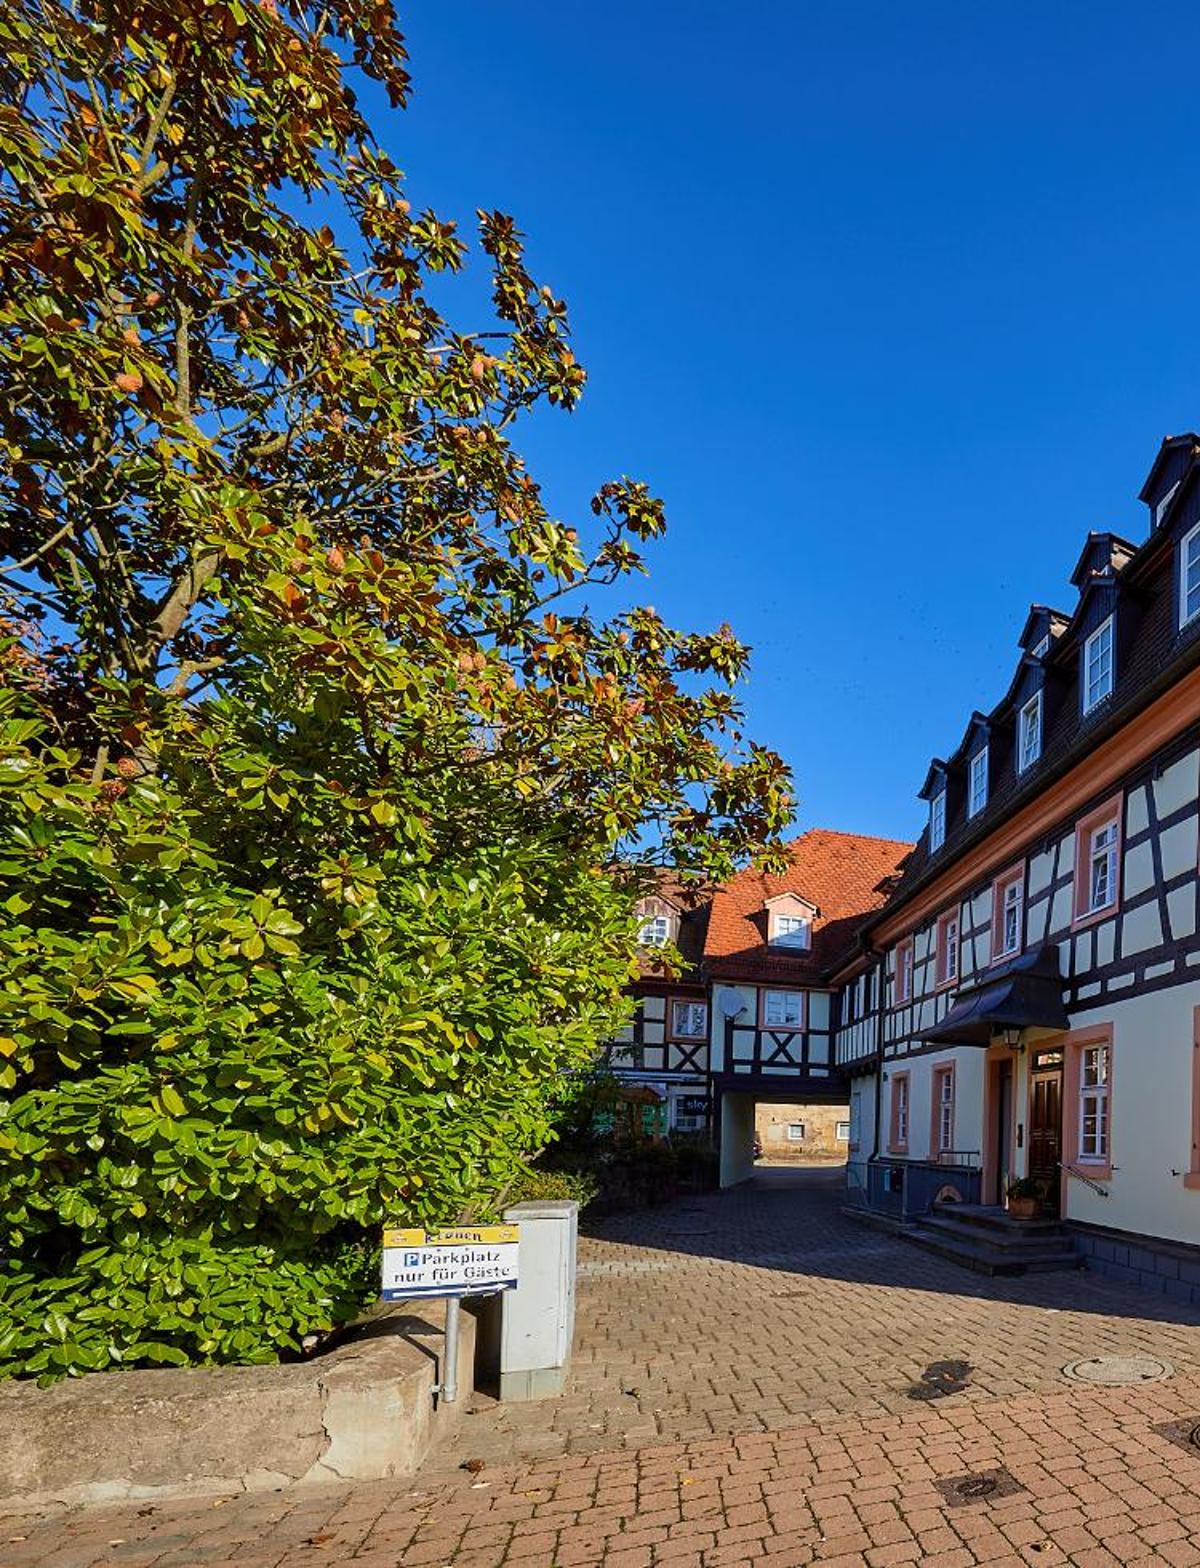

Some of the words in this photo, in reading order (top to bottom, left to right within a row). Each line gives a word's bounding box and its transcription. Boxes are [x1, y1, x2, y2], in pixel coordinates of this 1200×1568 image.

[422, 1250, 500, 1266] Parkplatz
[394, 1271, 425, 1282] nur
[432, 1268, 458, 1281] für
[463, 1265, 510, 1279] Gäste
